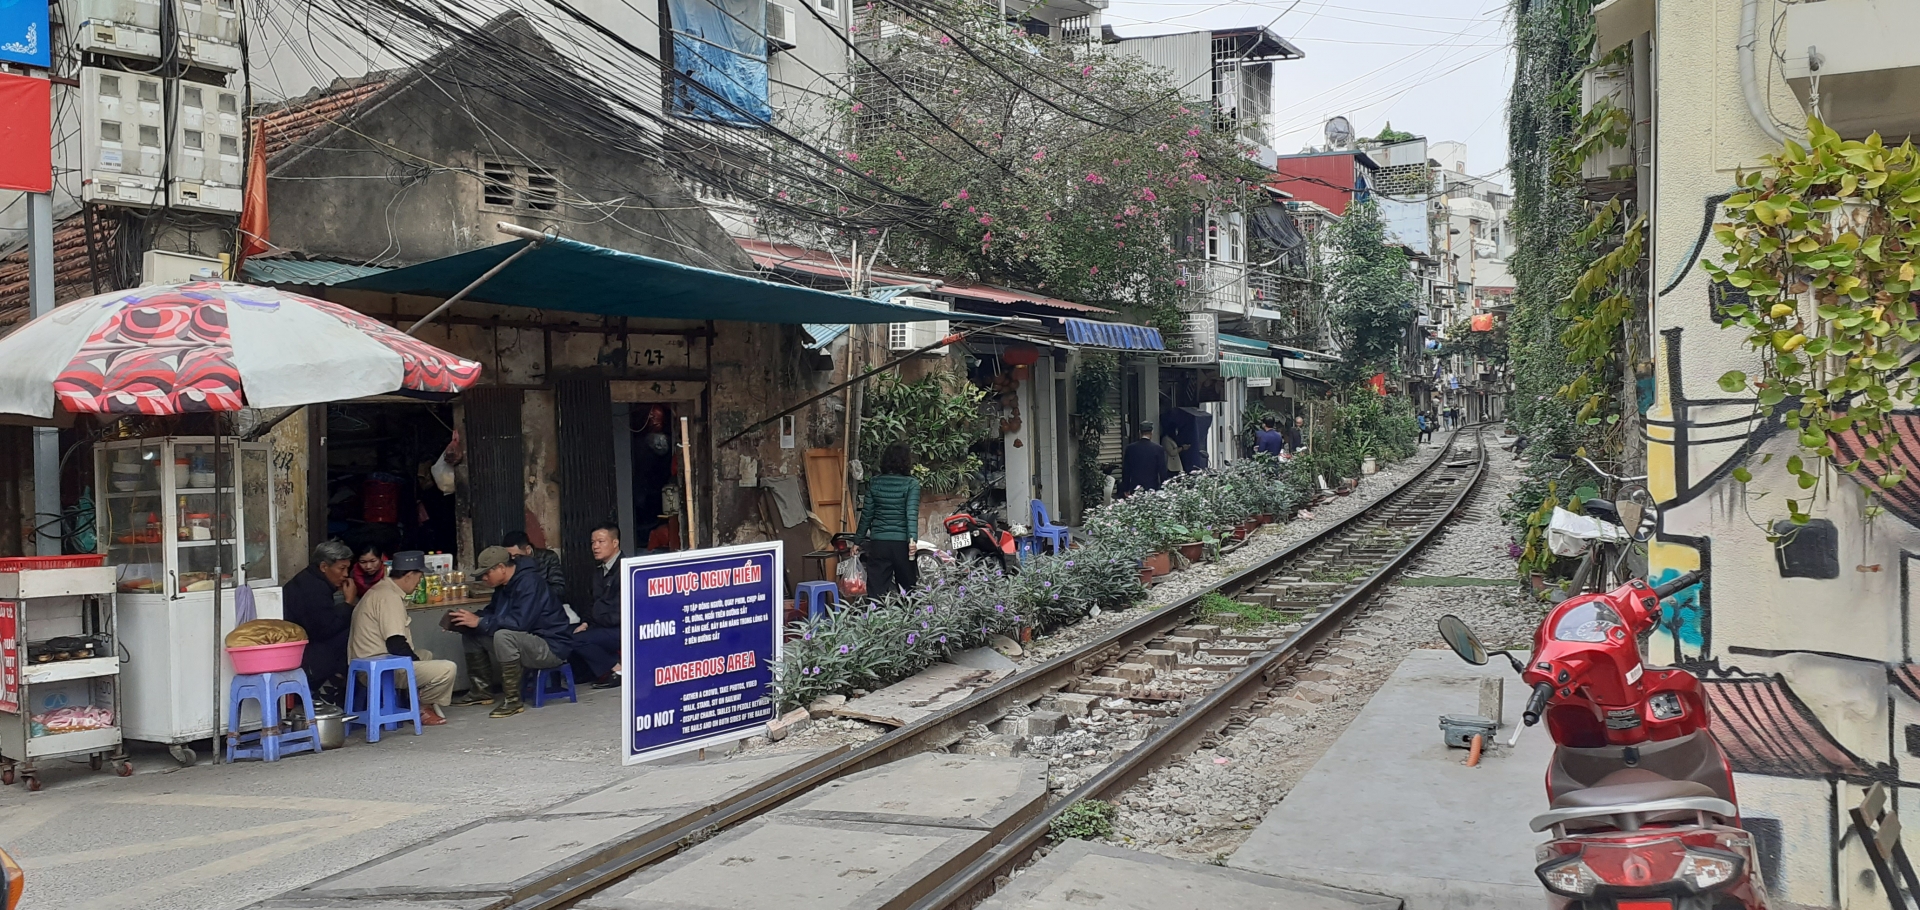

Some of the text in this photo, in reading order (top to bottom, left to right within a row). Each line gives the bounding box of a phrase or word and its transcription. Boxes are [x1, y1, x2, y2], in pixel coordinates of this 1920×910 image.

[644, 349, 664, 365] 27
[648, 560, 761, 597] KHU VỰC NGUY HIỂM
[639, 619, 676, 640] KHÔNG
[655, 650, 756, 686] DANGEROUS AREA
[683, 692, 698, 701] GATHER
[719, 685, 729, 693] TAKE
[729, 682, 745, 691] PHOTOS,
[746, 680, 757, 688] VIDEO
[682, 713, 700, 723] DISPLAY
[716, 707, 731, 716] TABLES
[731, 704, 736, 712] TO
[737, 702, 751, 711] PEDDLE
[683, 703, 696, 712] WALK,
[718, 697, 725, 705] ON
[725, 693, 742, 703] RAILWAY
[636, 709, 675, 731] DO NOT
[682, 708, 771, 734] THE RAILS AND ON BOTH SIDES OF THE RAILWAY
